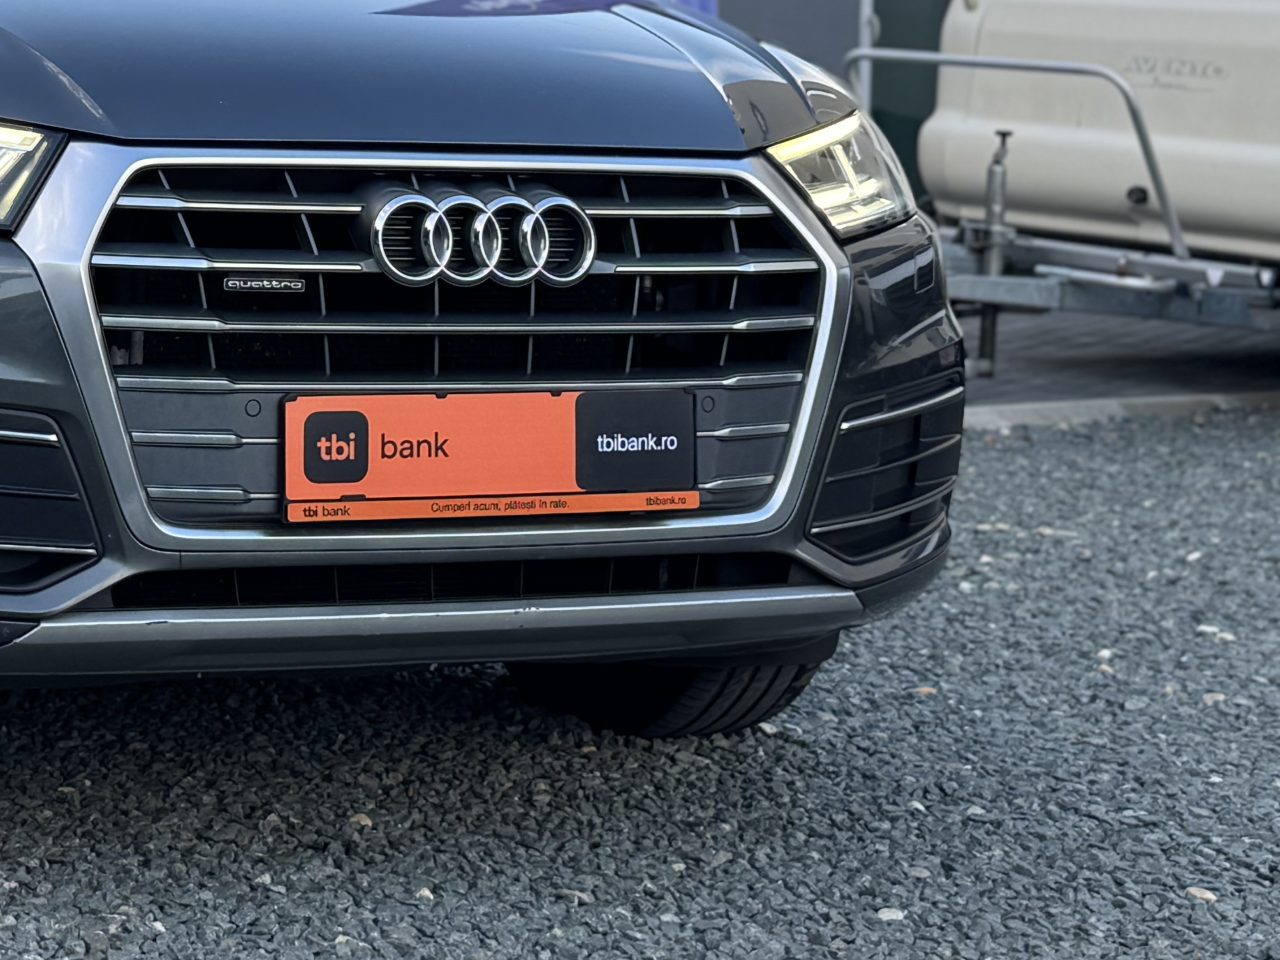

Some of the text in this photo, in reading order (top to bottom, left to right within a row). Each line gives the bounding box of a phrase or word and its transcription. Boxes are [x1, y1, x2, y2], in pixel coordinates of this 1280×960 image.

[227, 280, 302, 289] quattro
[316, 431, 450, 461] tbi bank
[596, 433, 678, 452] tbibank.ro
[646, 496, 686, 507] tbibank.ro
[303, 504, 351, 518] tbi bank
